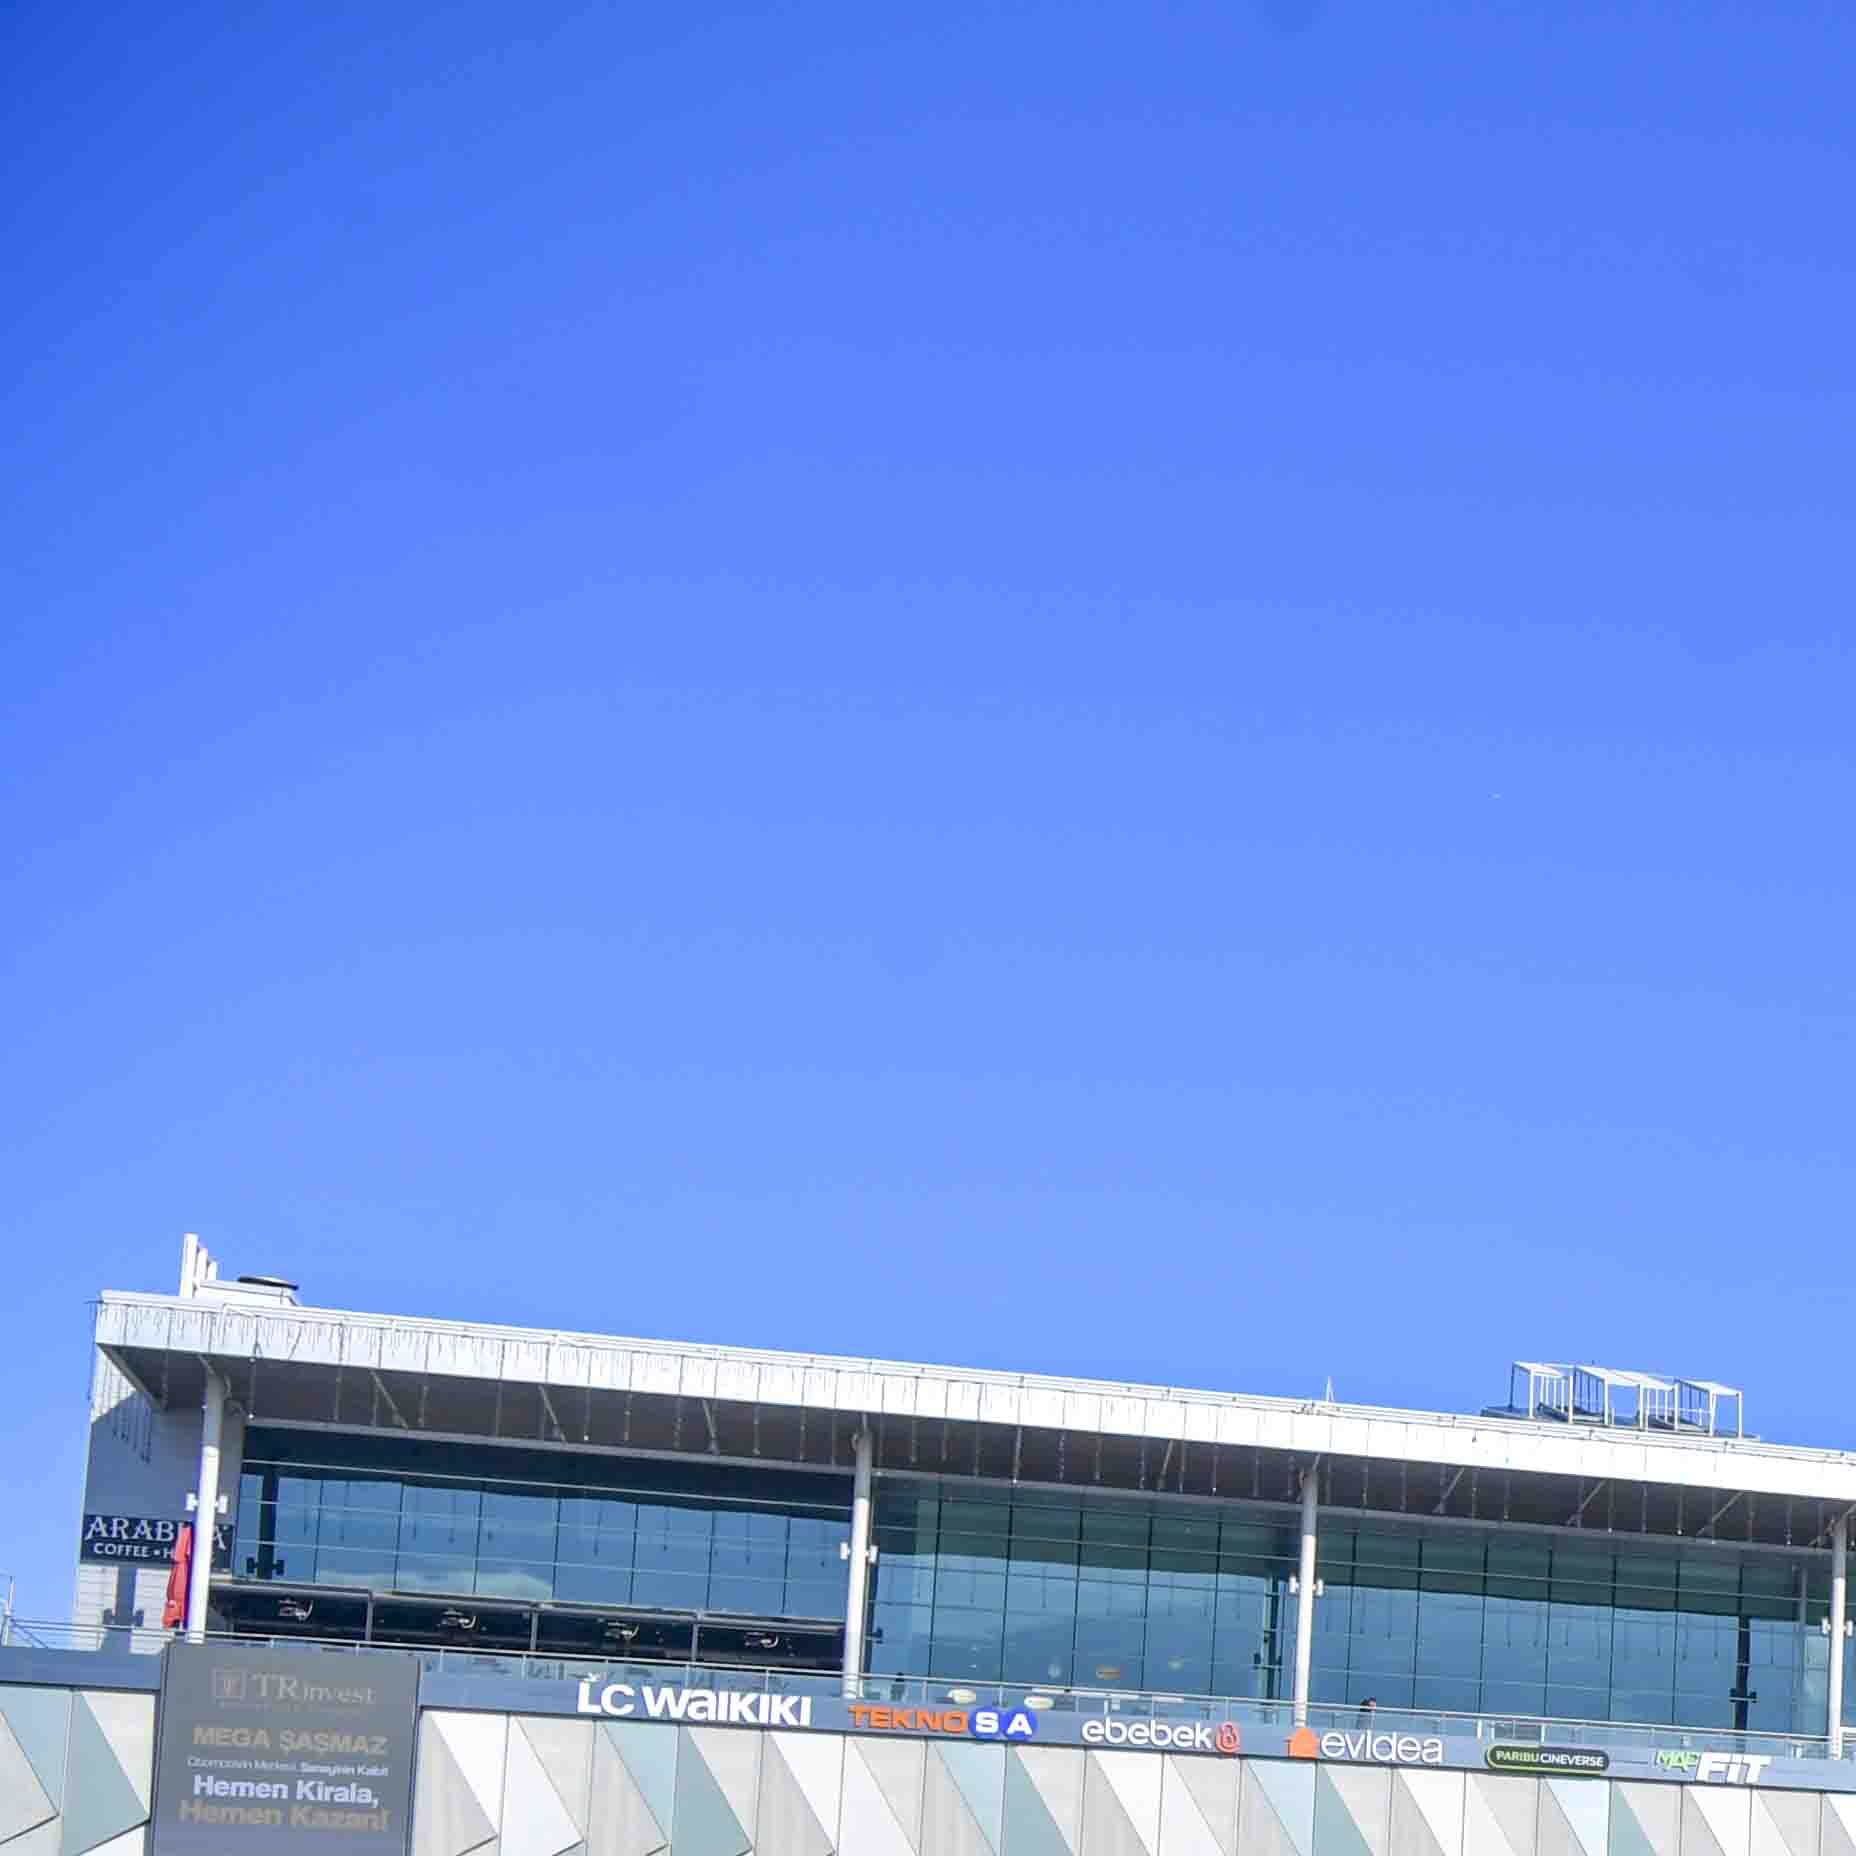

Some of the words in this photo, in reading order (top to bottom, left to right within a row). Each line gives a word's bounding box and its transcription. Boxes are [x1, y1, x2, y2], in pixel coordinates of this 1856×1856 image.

[94, 1542, 149, 1557] COFFEE
[577, 1680, 634, 1716] LC
[849, 1703, 1033, 1738] TEKNOSA
[1081, 1717, 1213, 1749] ebebek
[192, 1727, 272, 1748] MEGA
[279, 1730, 389, 1757] ŞAŞMAZ
[1320, 1729, 1444, 1763] evidea
[1540, 1752, 1604, 1767] CINEVERSE
[193, 1775, 289, 1800] Hemen
[296, 1779, 380, 1809] Kirala,
[178, 1799, 284, 1826] Hemen
